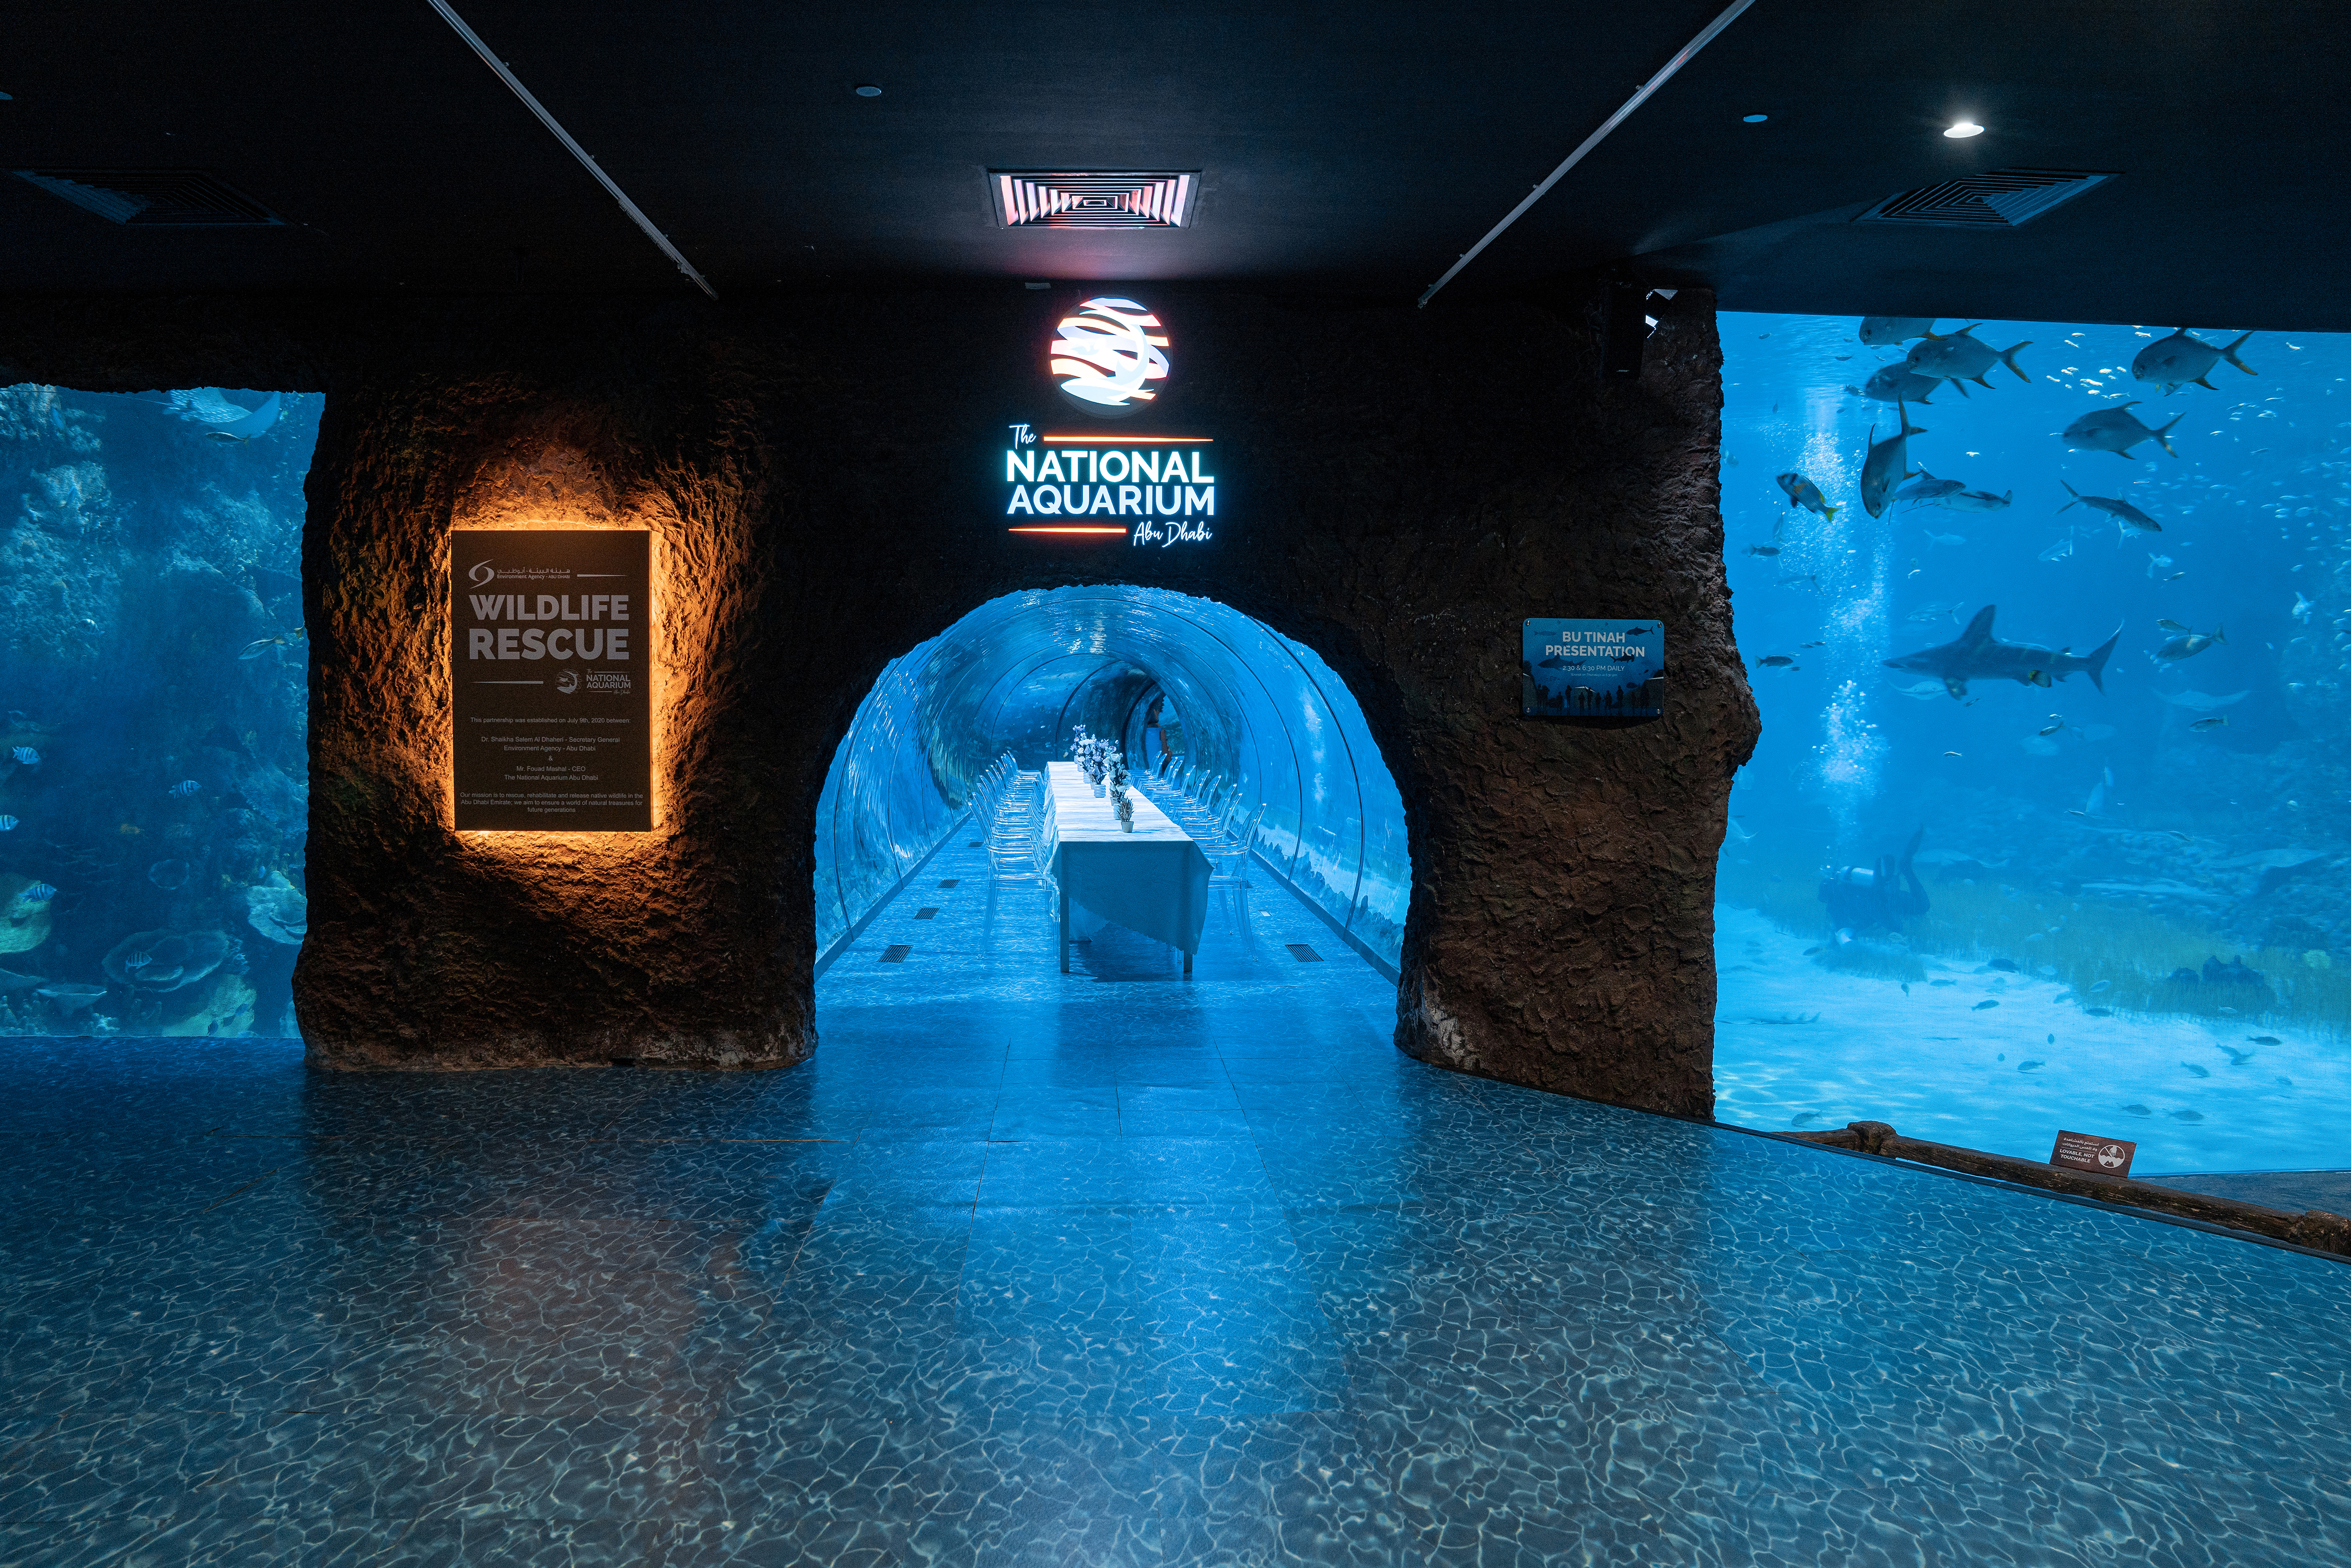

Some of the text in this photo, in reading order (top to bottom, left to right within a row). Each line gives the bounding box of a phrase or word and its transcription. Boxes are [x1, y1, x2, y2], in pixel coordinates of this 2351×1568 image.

[1009, 424, 1036, 449] The
[1006, 450, 1214, 483] NATIONAL
[1007, 485, 1214, 516] AQUARIUM
[1133, 521, 1212, 547] Abu Dhabi
[469, 595, 629, 620] WILDLIFE
[470, 628, 629, 660] RESCUE
[1562, 631, 1625, 643] BU TINAH
[1545, 645, 1645, 657] PRESENTATION
[2061, 1154, 2090, 1163] TOUCHABLE
